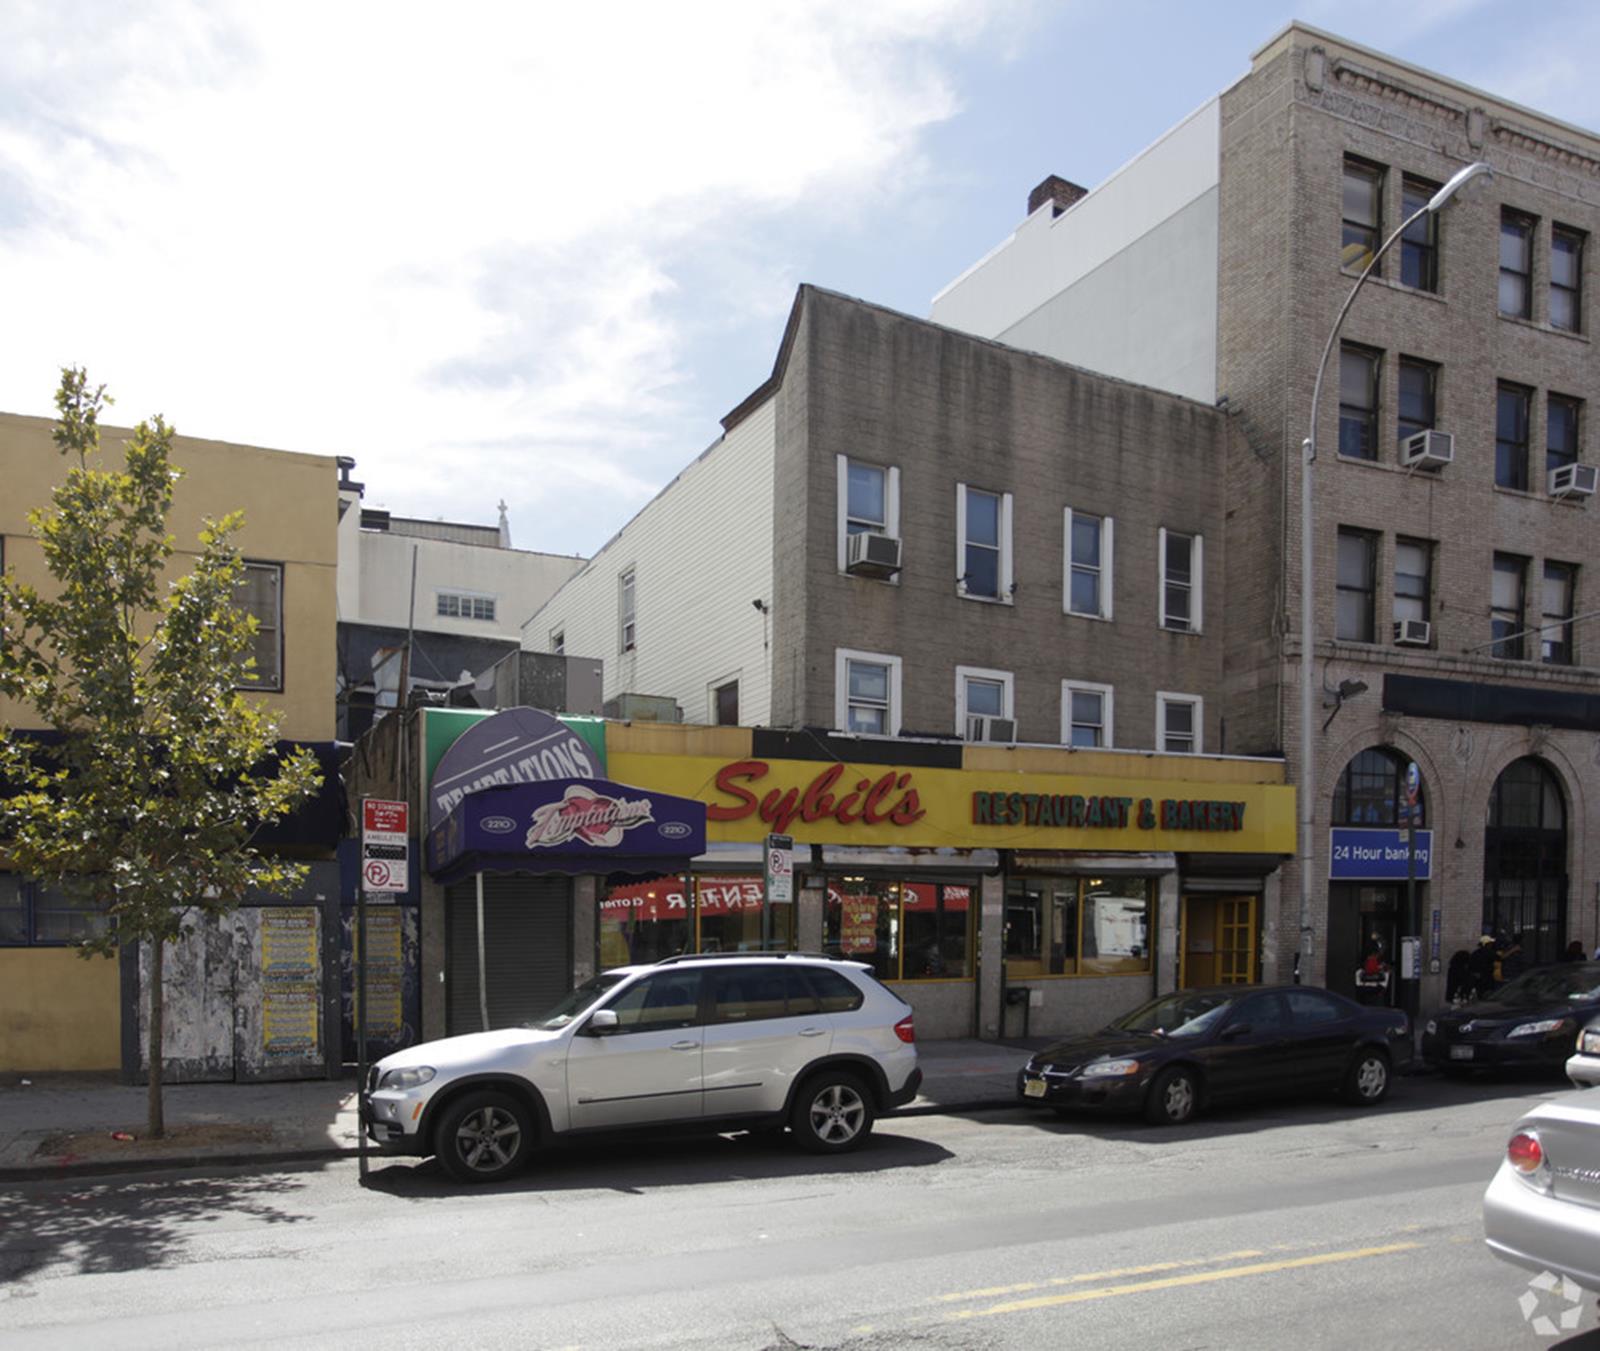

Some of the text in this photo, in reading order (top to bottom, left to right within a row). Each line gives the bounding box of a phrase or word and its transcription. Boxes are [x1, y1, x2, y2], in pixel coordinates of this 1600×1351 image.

[437, 738, 595, 814] TETATIONS
[706, 760, 927, 834] Sybil's
[972, 790, 1247, 832] RESTAURANT & BAKERY
[1334, 846, 1428, 864] 24 Hour bankng
